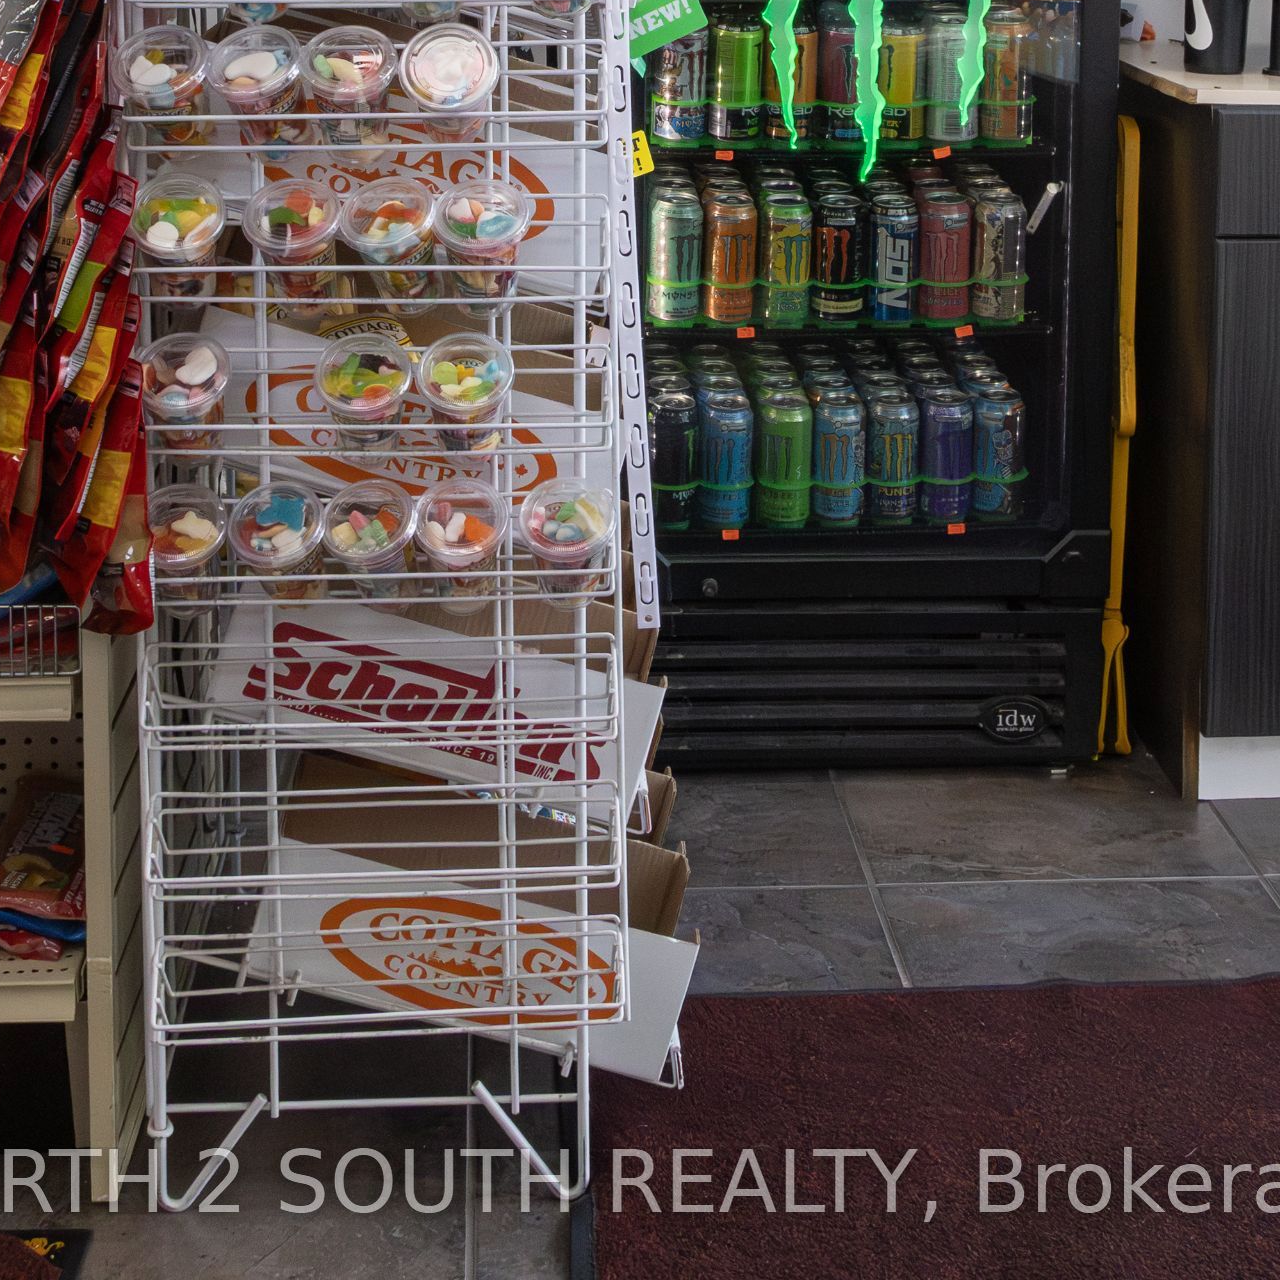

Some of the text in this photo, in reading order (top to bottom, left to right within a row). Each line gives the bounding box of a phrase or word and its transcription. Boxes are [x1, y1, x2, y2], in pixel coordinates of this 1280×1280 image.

[995, 709, 1037, 728] idw
[368, 912, 583, 995] COTTAGE
[383, 953, 551, 1006] COUNTRY
